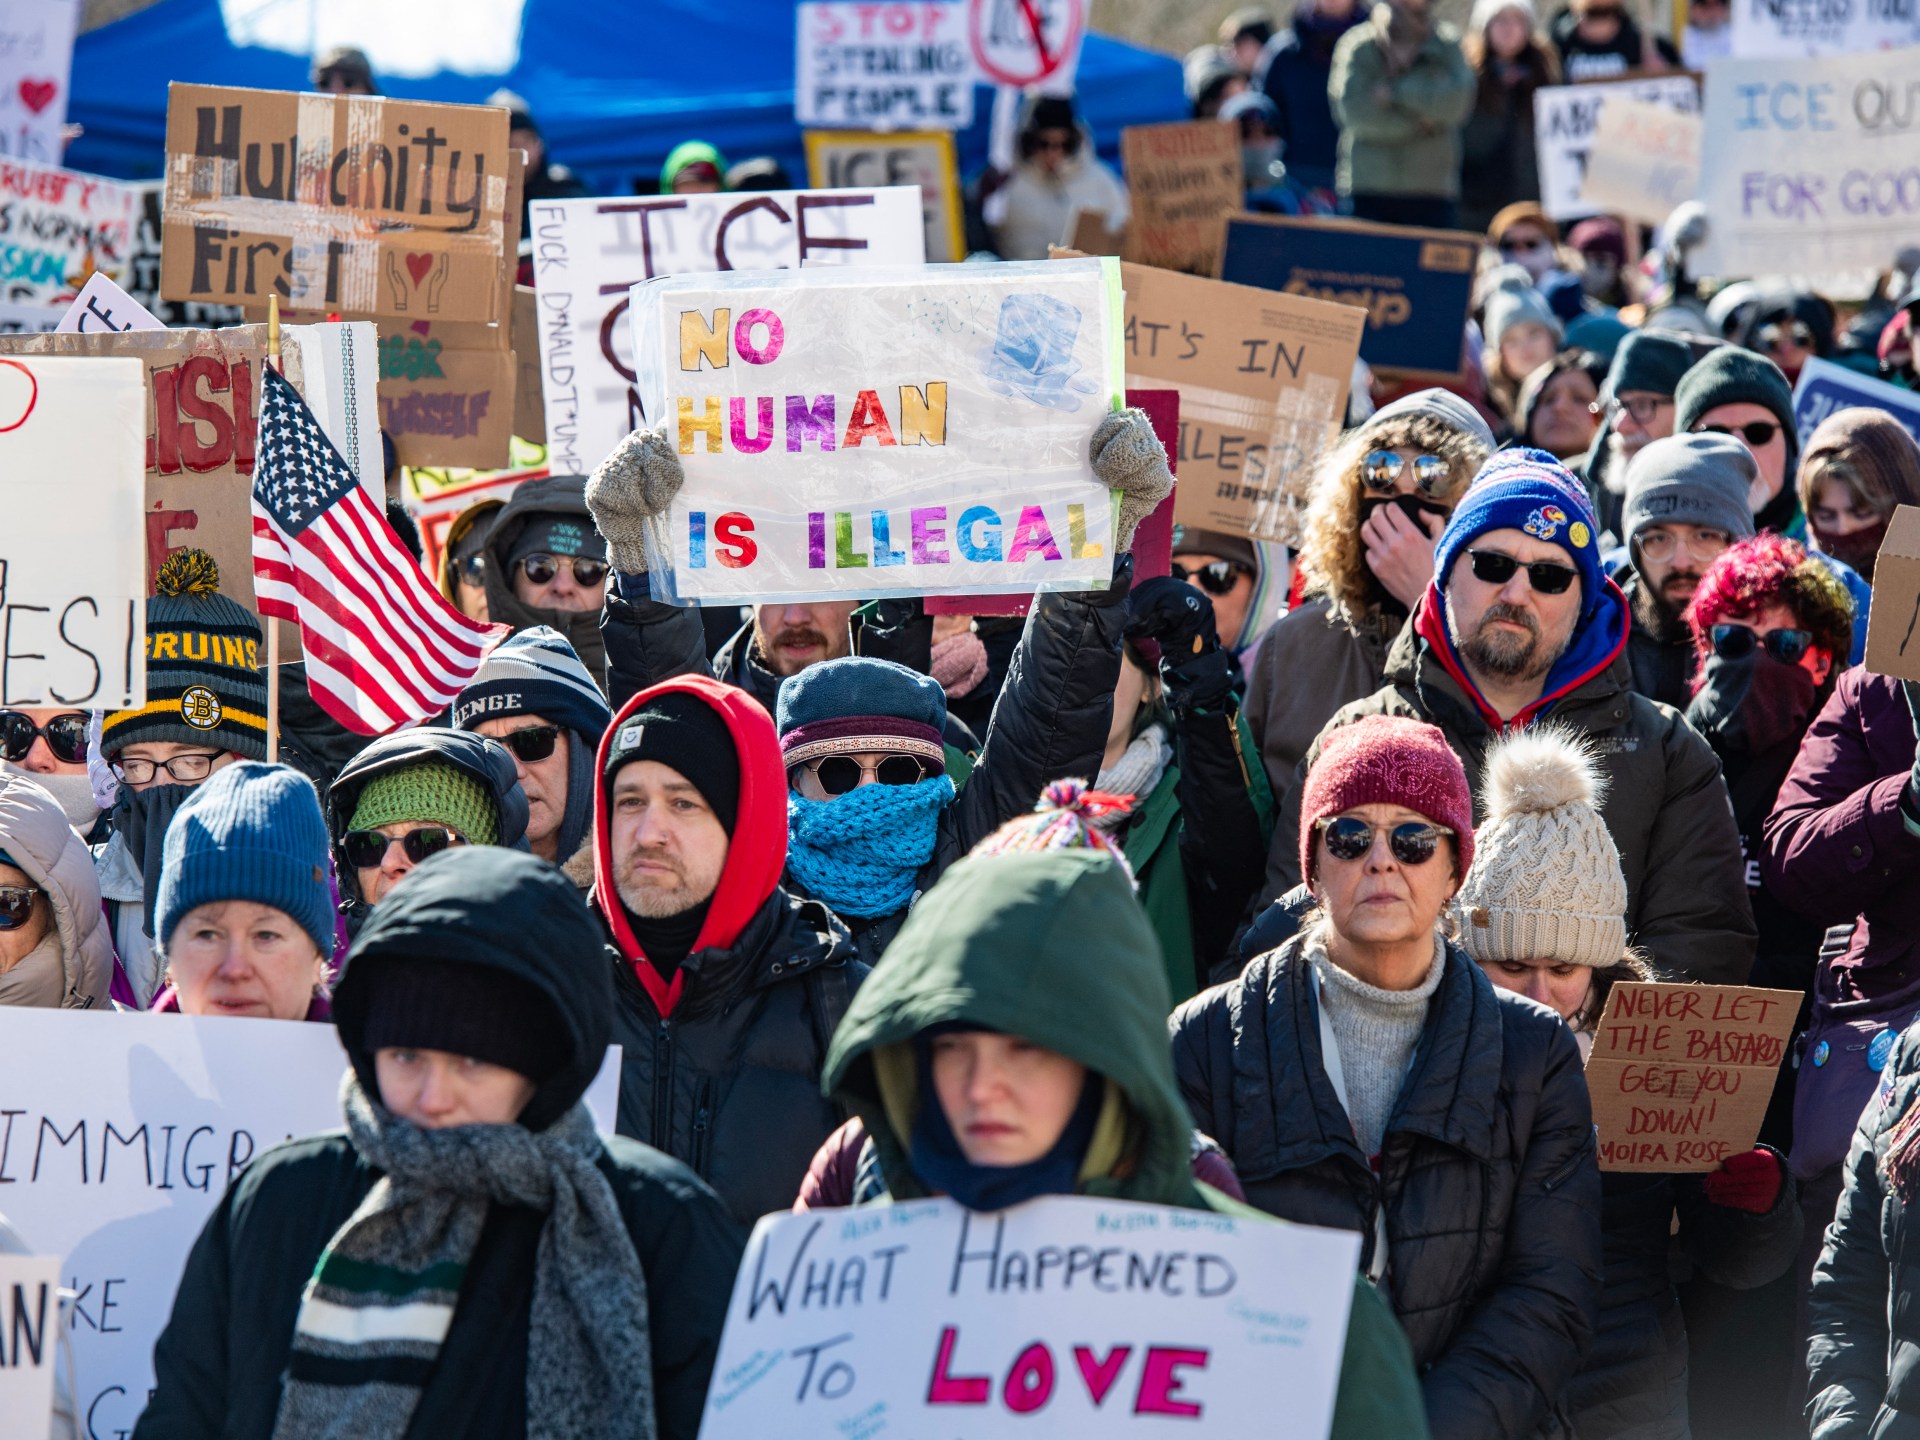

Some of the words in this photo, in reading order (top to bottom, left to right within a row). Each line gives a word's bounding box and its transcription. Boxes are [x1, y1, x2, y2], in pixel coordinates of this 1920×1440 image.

[814, 3, 945, 43] STOP
[814, 83, 957, 116] PEOPLE
[1734, 81, 1836, 131] ICE
[1740, 170, 1826, 220] FOR
[535, 206, 571, 275] FUCK
[679, 307, 785, 372] NO
[1236, 338, 1306, 380] IN
[676, 380, 948, 455] HUMAN
[688, 511, 759, 569] IS
[808, 503, 1104, 570] ILLEGAL
[193, 693, 213, 719] B
[1613, 988, 1704, 1023] NEVER
[1711, 993, 1780, 1024] LET
[1606, 1023, 1672, 1055] THE
[1686, 1029, 1784, 1067] BASTARDS
[1619, 1064, 1688, 1099] GET
[1690, 1066, 1742, 1105] YOU
[1626, 1098, 1717, 1136] DOWN!
[1598, 1140, 1670, 1164] MOIRA
[1674, 1140, 1731, 1164] ROSE
[747, 1216, 910, 1323] WHAT
[949, 1208, 1238, 1298] HAPPENED
[925, 1324, 1210, 1418] LOVE
